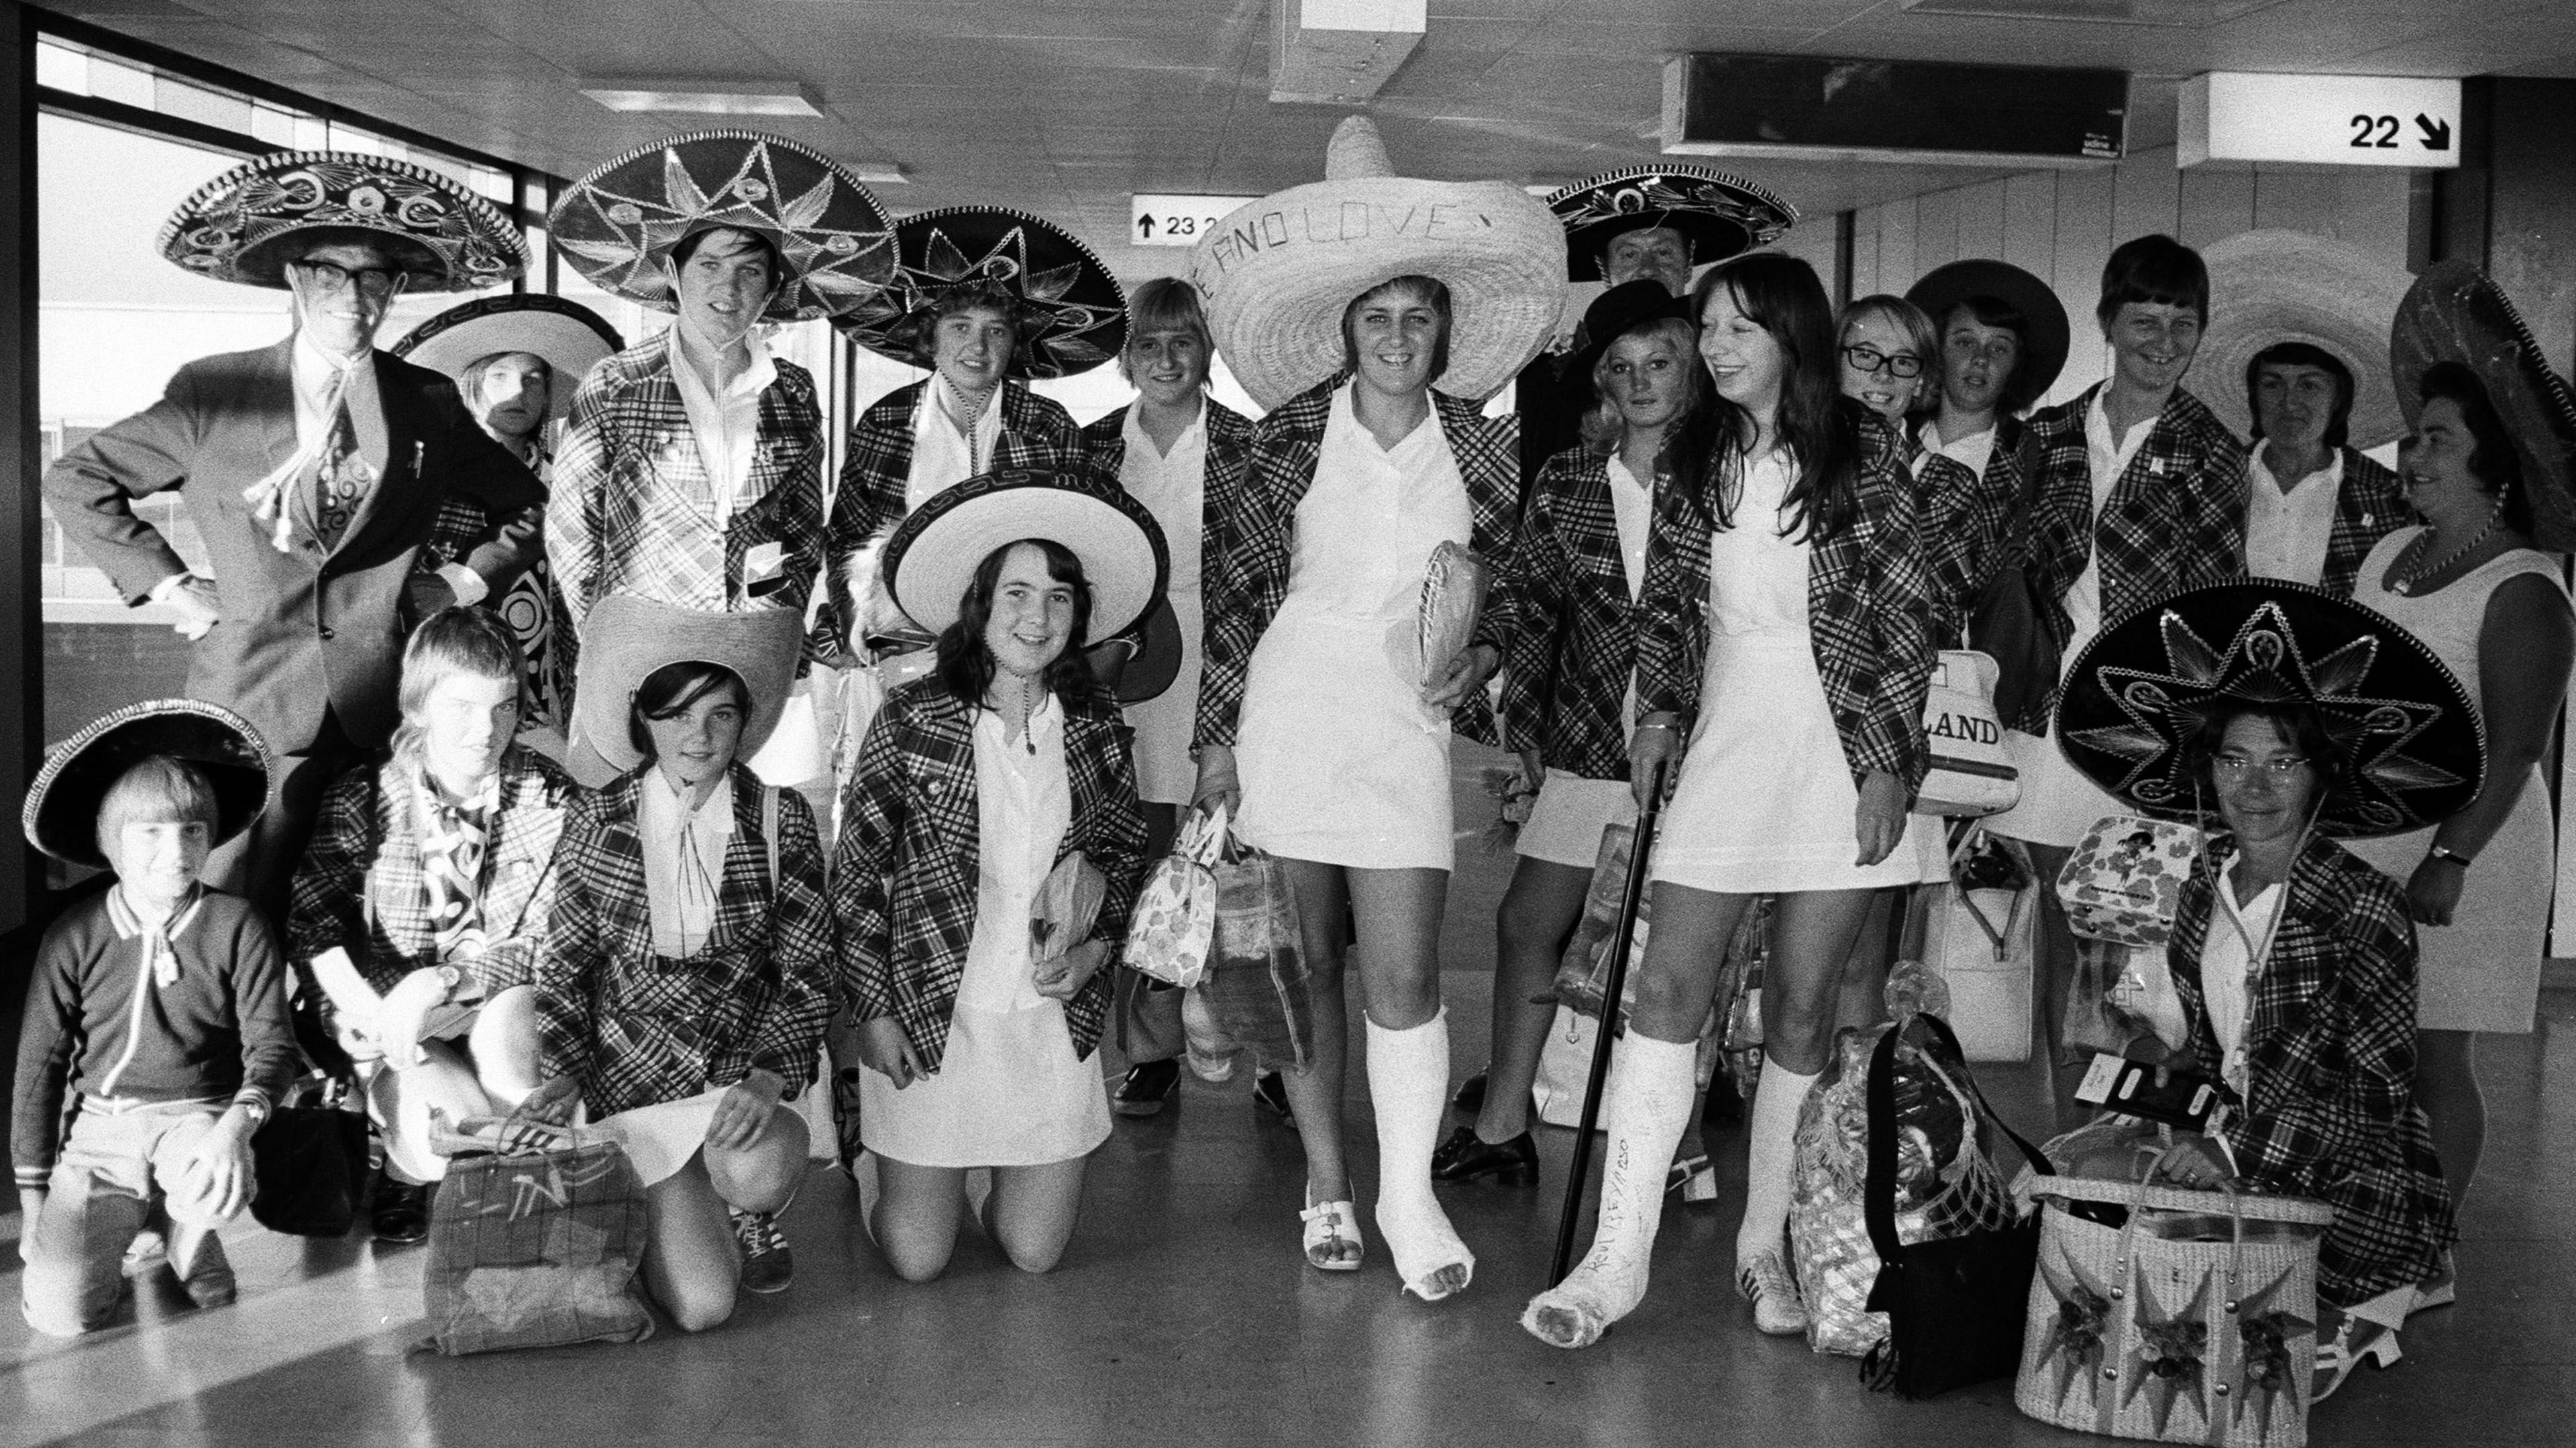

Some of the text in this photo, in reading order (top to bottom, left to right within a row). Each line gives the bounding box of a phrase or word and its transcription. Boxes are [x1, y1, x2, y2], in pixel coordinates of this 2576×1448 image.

[2350, 114, 2400, 148] 22
[1167, 217, 1195, 235] 23
[1303, 201, 1458, 244] LOVE
